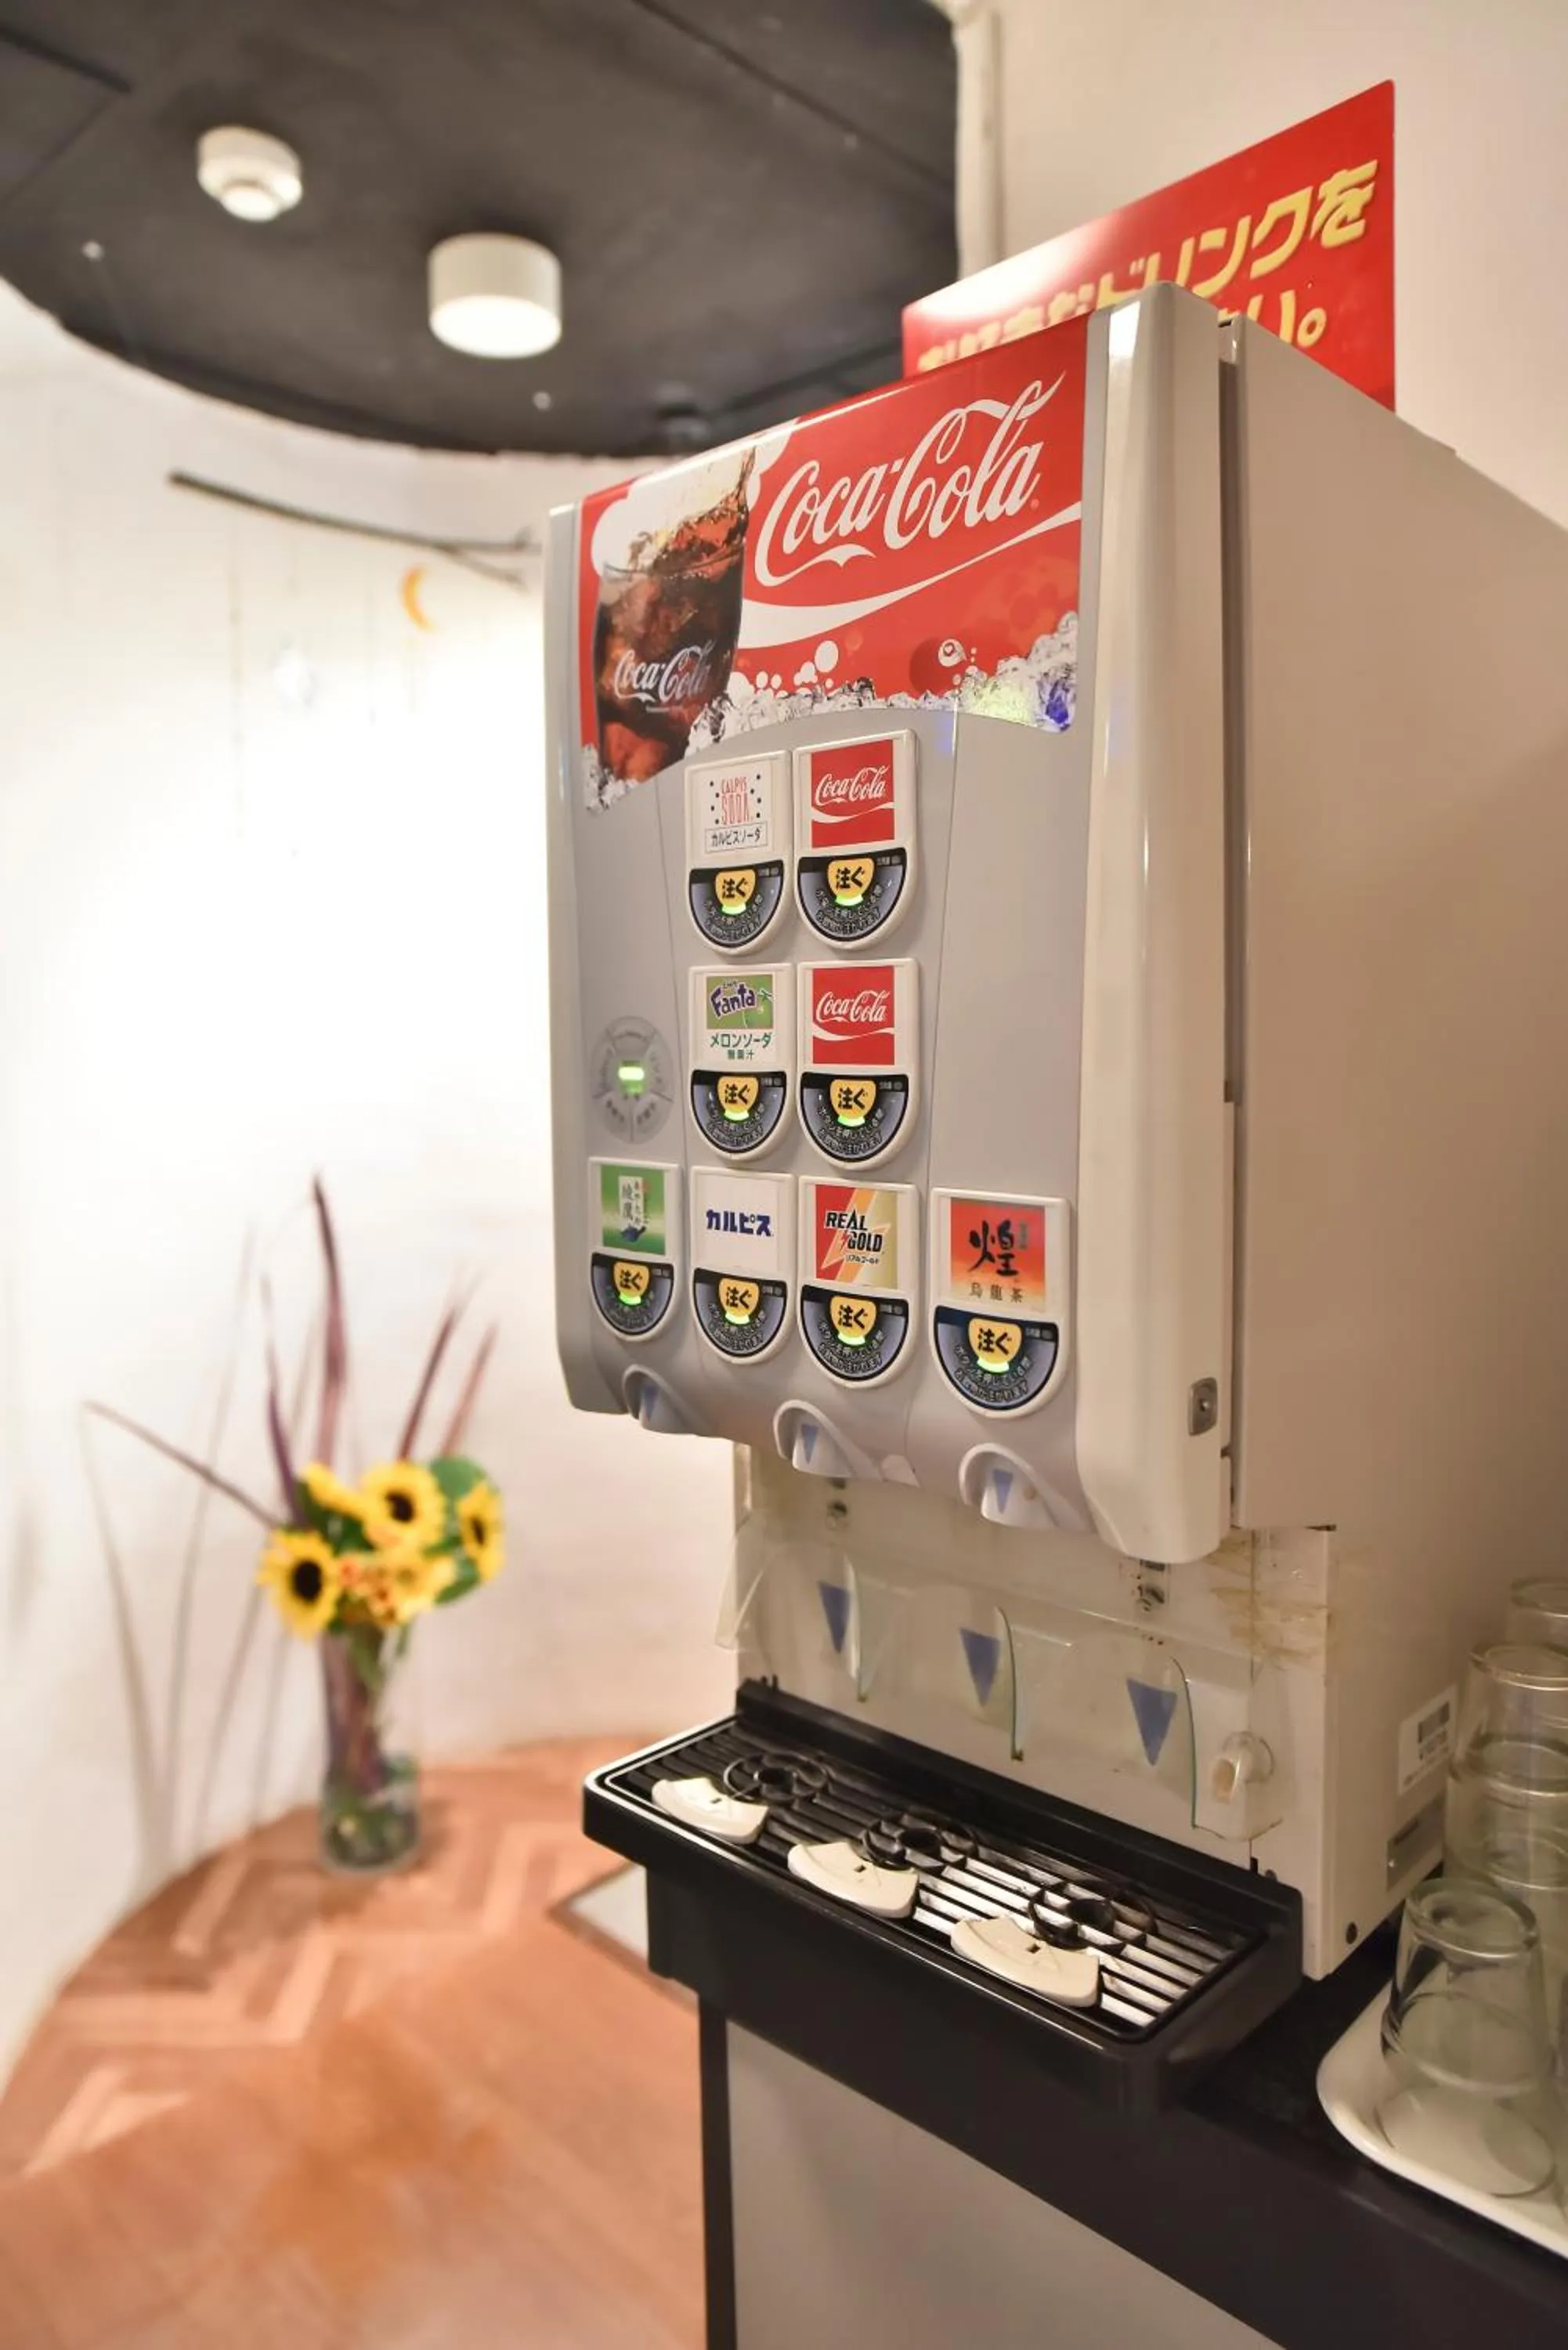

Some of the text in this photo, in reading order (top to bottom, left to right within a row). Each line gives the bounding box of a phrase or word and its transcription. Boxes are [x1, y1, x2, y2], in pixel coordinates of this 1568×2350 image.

[754, 371, 1065, 587] Coca-Cola
[614, 639, 716, 703] Coca-Cola
[815, 765, 890, 805] Coca-Cola
[722, 877, 748, 898] 注ぐ
[836, 866, 865, 889] 注ぐ
[710, 983, 757, 1018] Fanta
[816, 990, 890, 1023] Coca-Cola
[710, 1032, 772, 1048] メロンソーダ
[724, 1083, 750, 1104] 注ぐ
[838, 1086, 869, 1110] 注ぐ
[706, 1209, 771, 1237] カルピス
[826, 1209, 868, 1231] REAL
[847, 1231, 883, 1252] GOLD
[620, 1270, 643, 1291] 注ぐ
[726, 1286, 752, 1309] 注ぐ
[838, 1305, 869, 1329] 注ぐ
[977, 1329, 1013, 1355] 注ぐ
